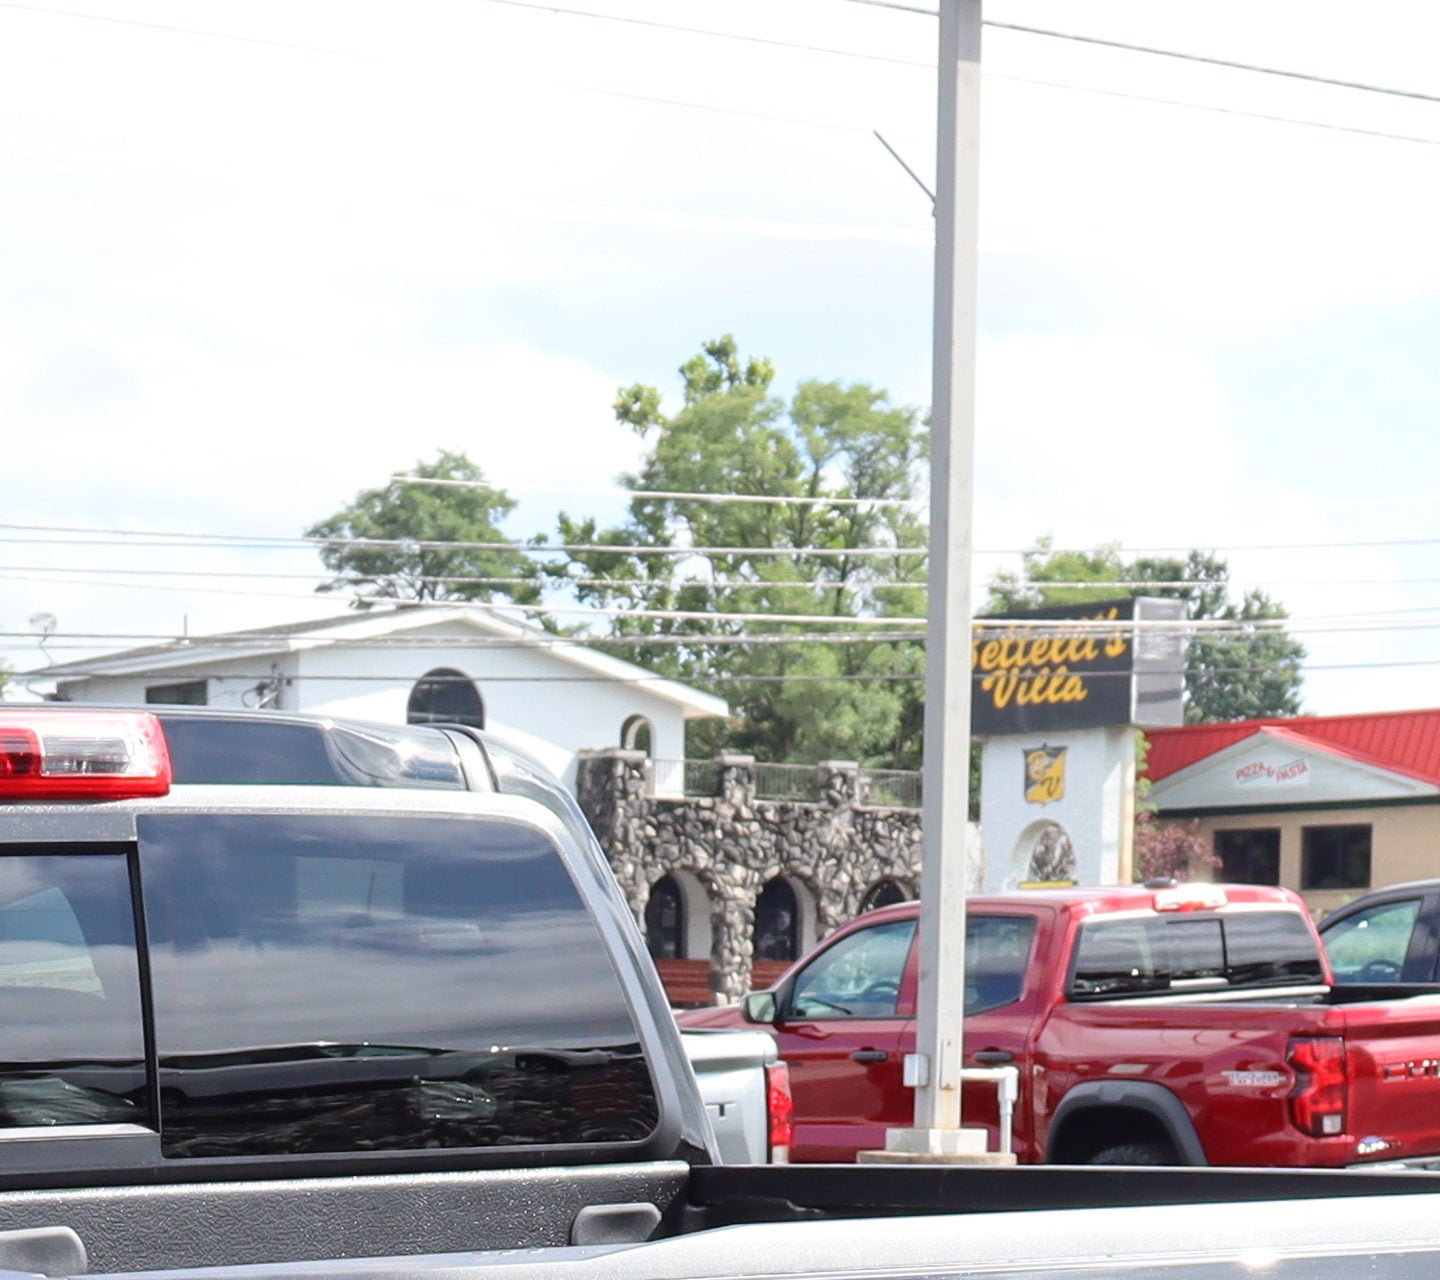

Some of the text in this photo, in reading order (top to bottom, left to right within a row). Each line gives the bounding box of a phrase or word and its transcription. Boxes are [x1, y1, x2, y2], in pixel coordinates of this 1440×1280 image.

[982, 665, 1088, 709] Villa
[1236, 761, 1265, 781] PIZZA
[1276, 762, 1309, 783] PASTA
